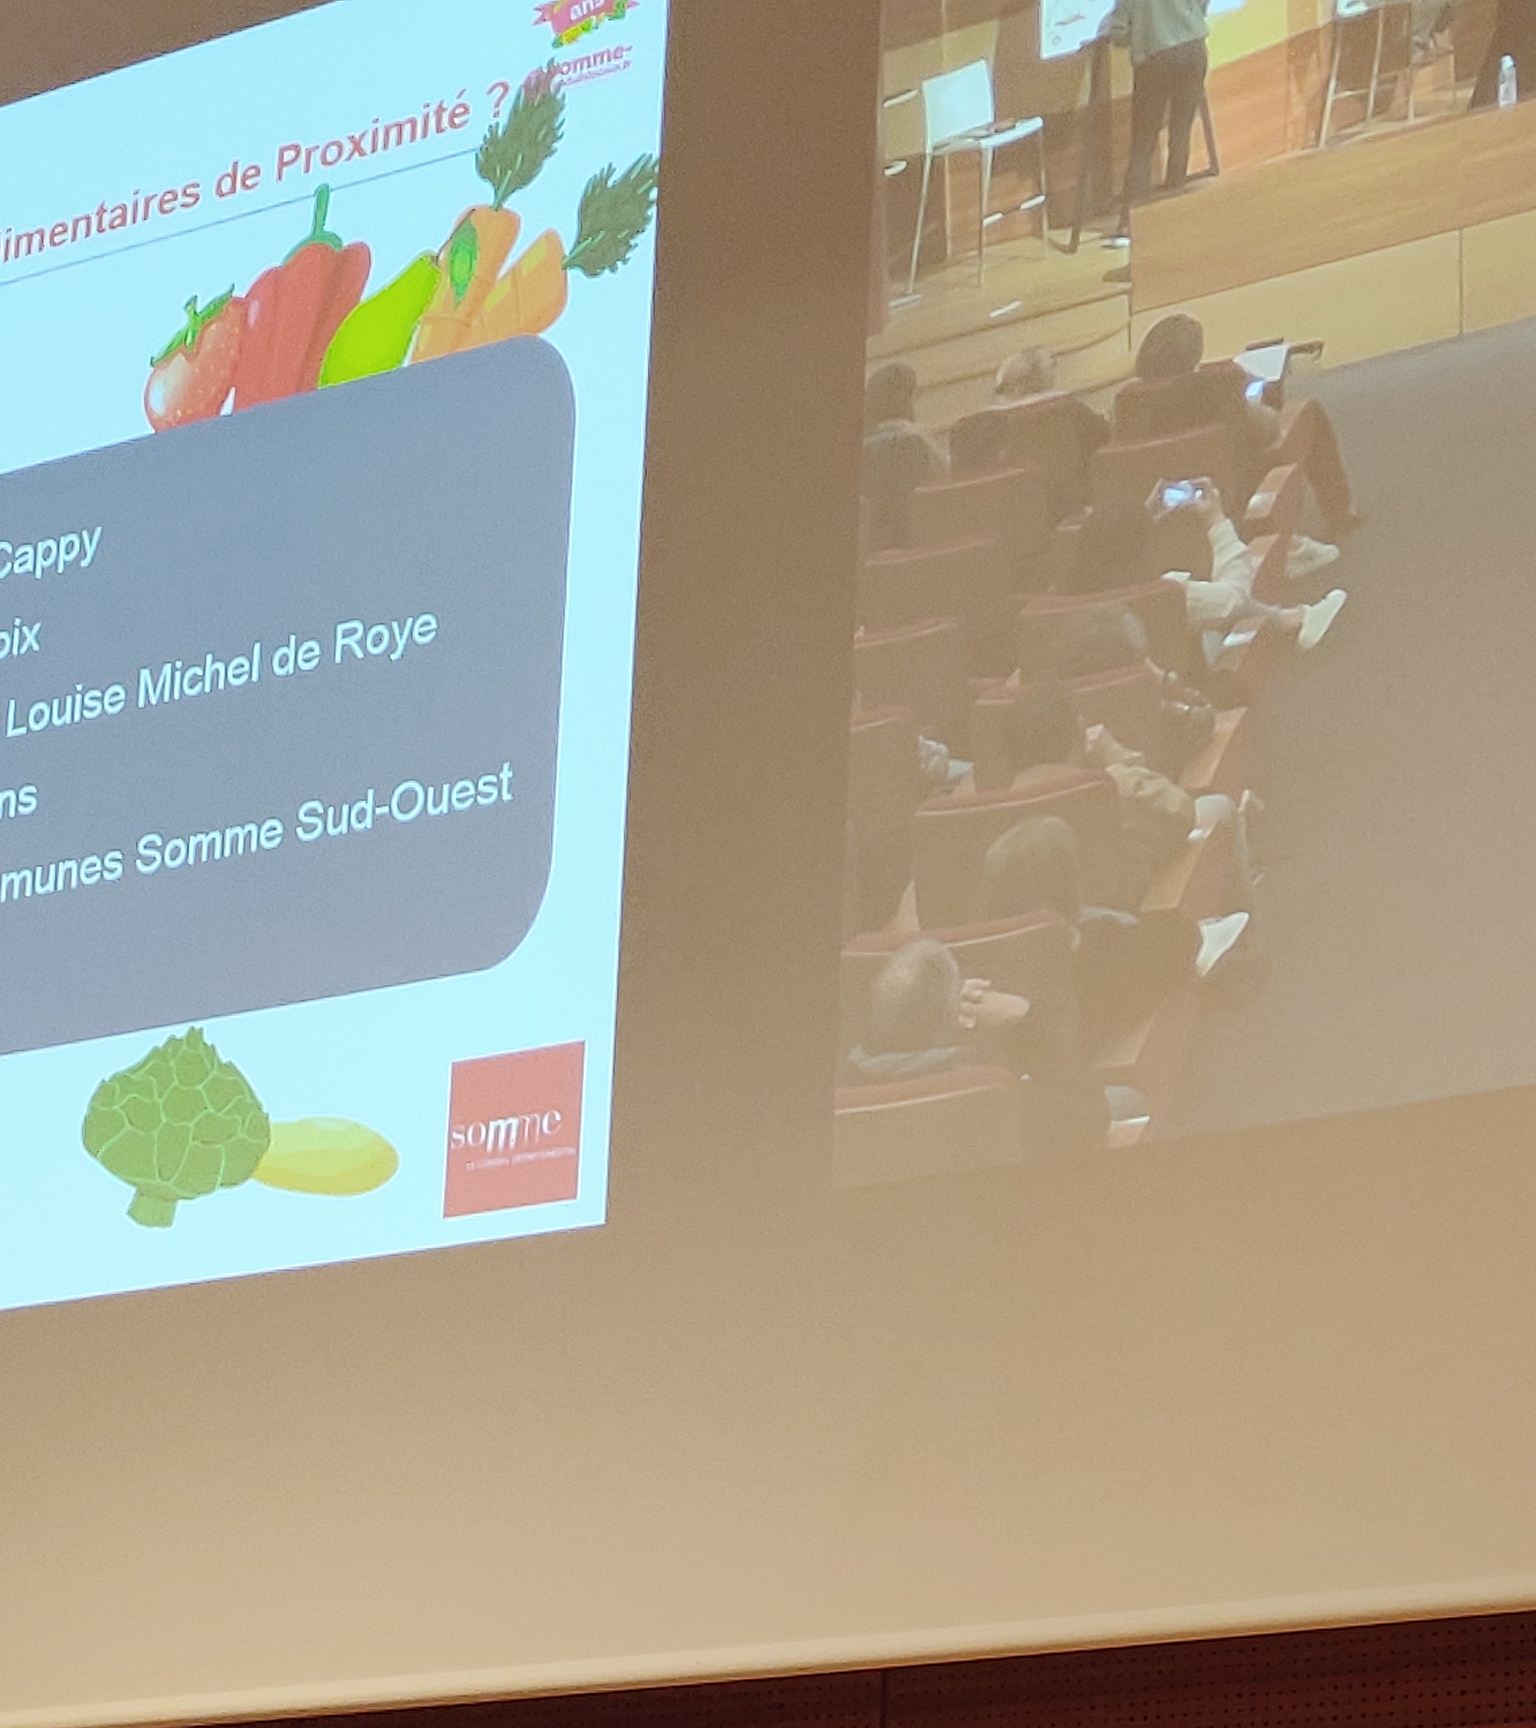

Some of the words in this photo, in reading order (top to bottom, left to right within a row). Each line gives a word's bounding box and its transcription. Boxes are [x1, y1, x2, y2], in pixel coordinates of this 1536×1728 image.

[214, 160, 262, 199] de
[275, 89, 472, 183] Proximité
[486, 80, 511, 119] ?
[5, 682, 126, 738] Louise
[137, 641, 261, 708] Michel
[272, 634, 321, 677] de
[334, 612, 438, 664] Roye
[135, 817, 283, 875] Somme
[295, 761, 513, 843] Sud-Ouest
